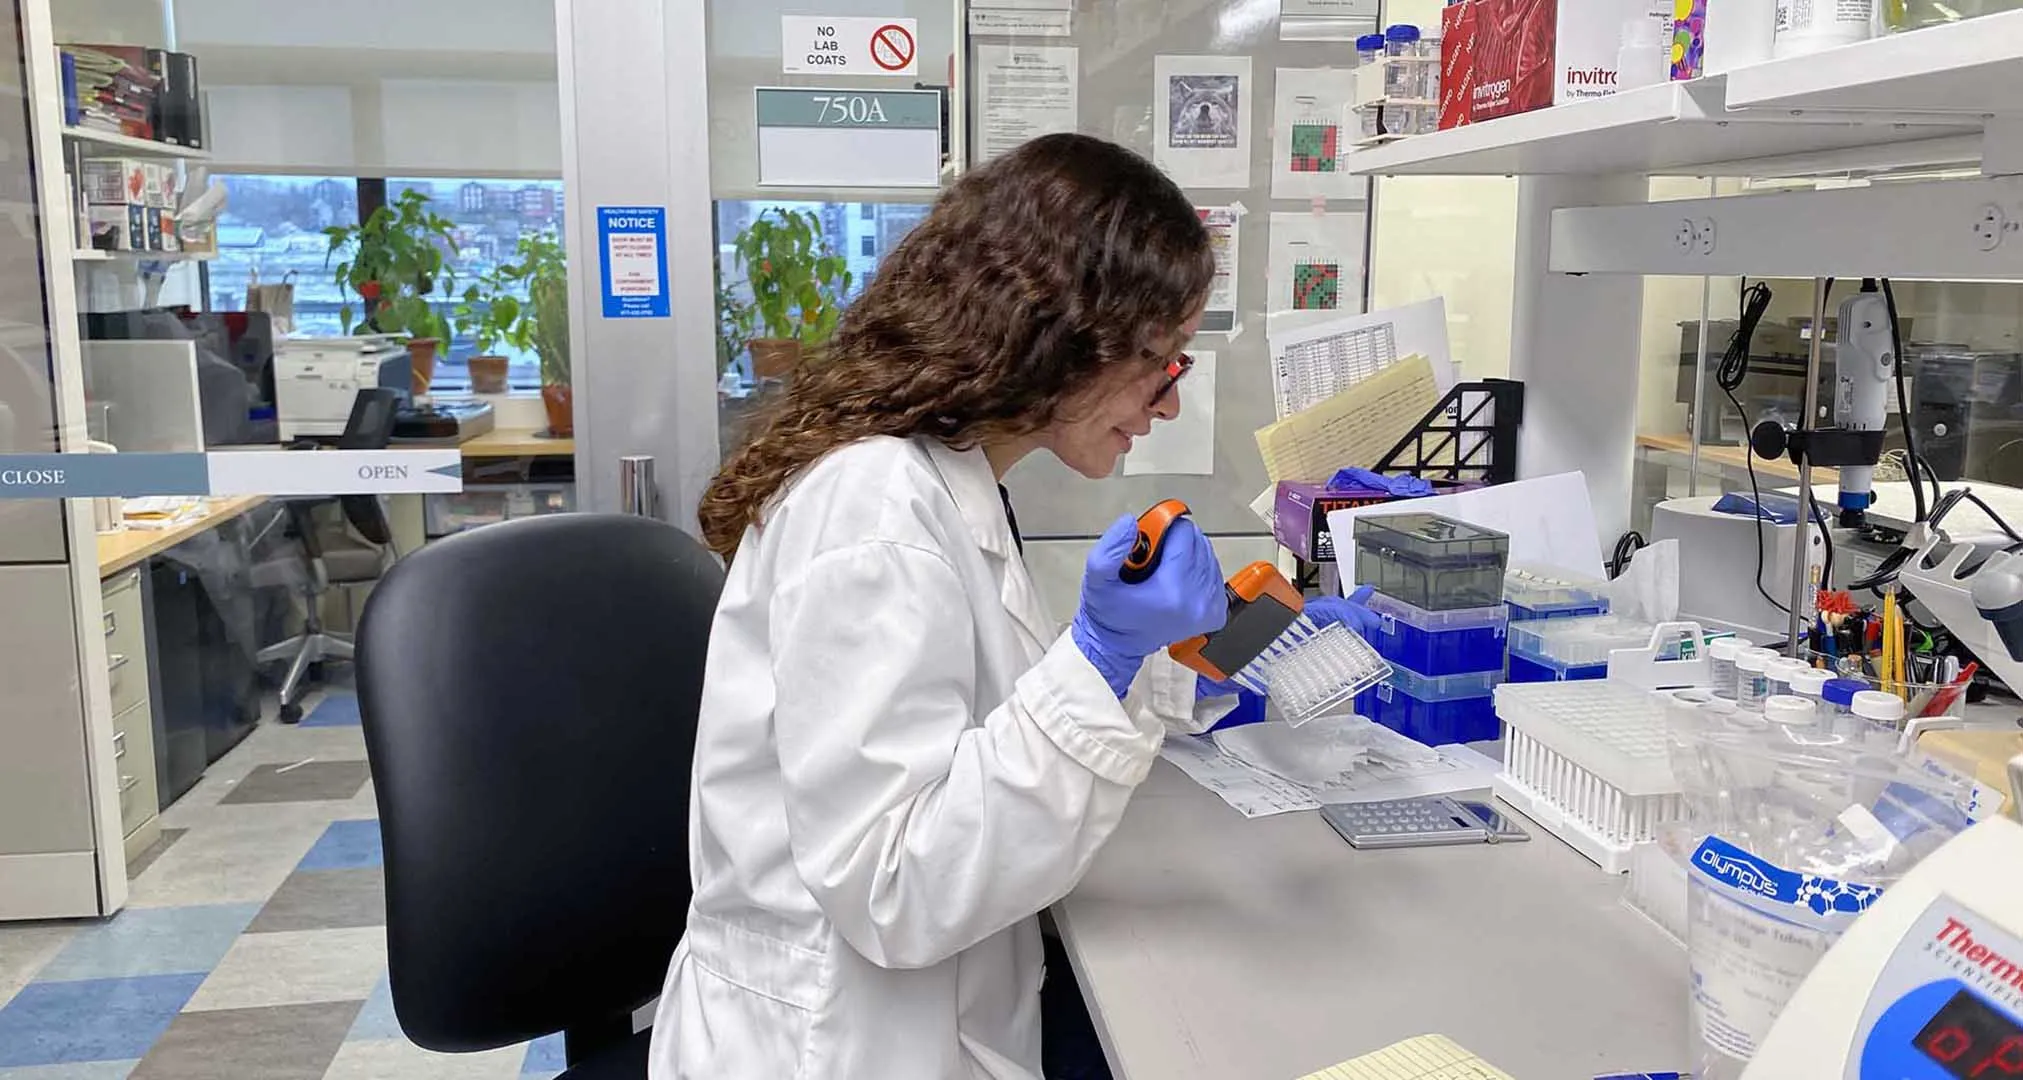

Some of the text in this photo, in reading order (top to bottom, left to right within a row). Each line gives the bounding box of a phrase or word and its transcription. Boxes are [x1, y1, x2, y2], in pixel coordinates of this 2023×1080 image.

[817, 26, 836, 37] NO
[814, 41, 839, 51] LAB
[807, 55, 847, 66] COATS
[1472, 79, 1511, 99] invitrogen
[1576, 89, 1602, 97] Thermo
[813, 96, 888, 123] 750A
[608, 217, 656, 229] NOTICE
[2, 470, 65, 485] CLOSE
[358, 464, 409, 480] OPEN
[1701, 848, 1778, 896] Olympus
[1936, 916, 2023, 992] Therm
